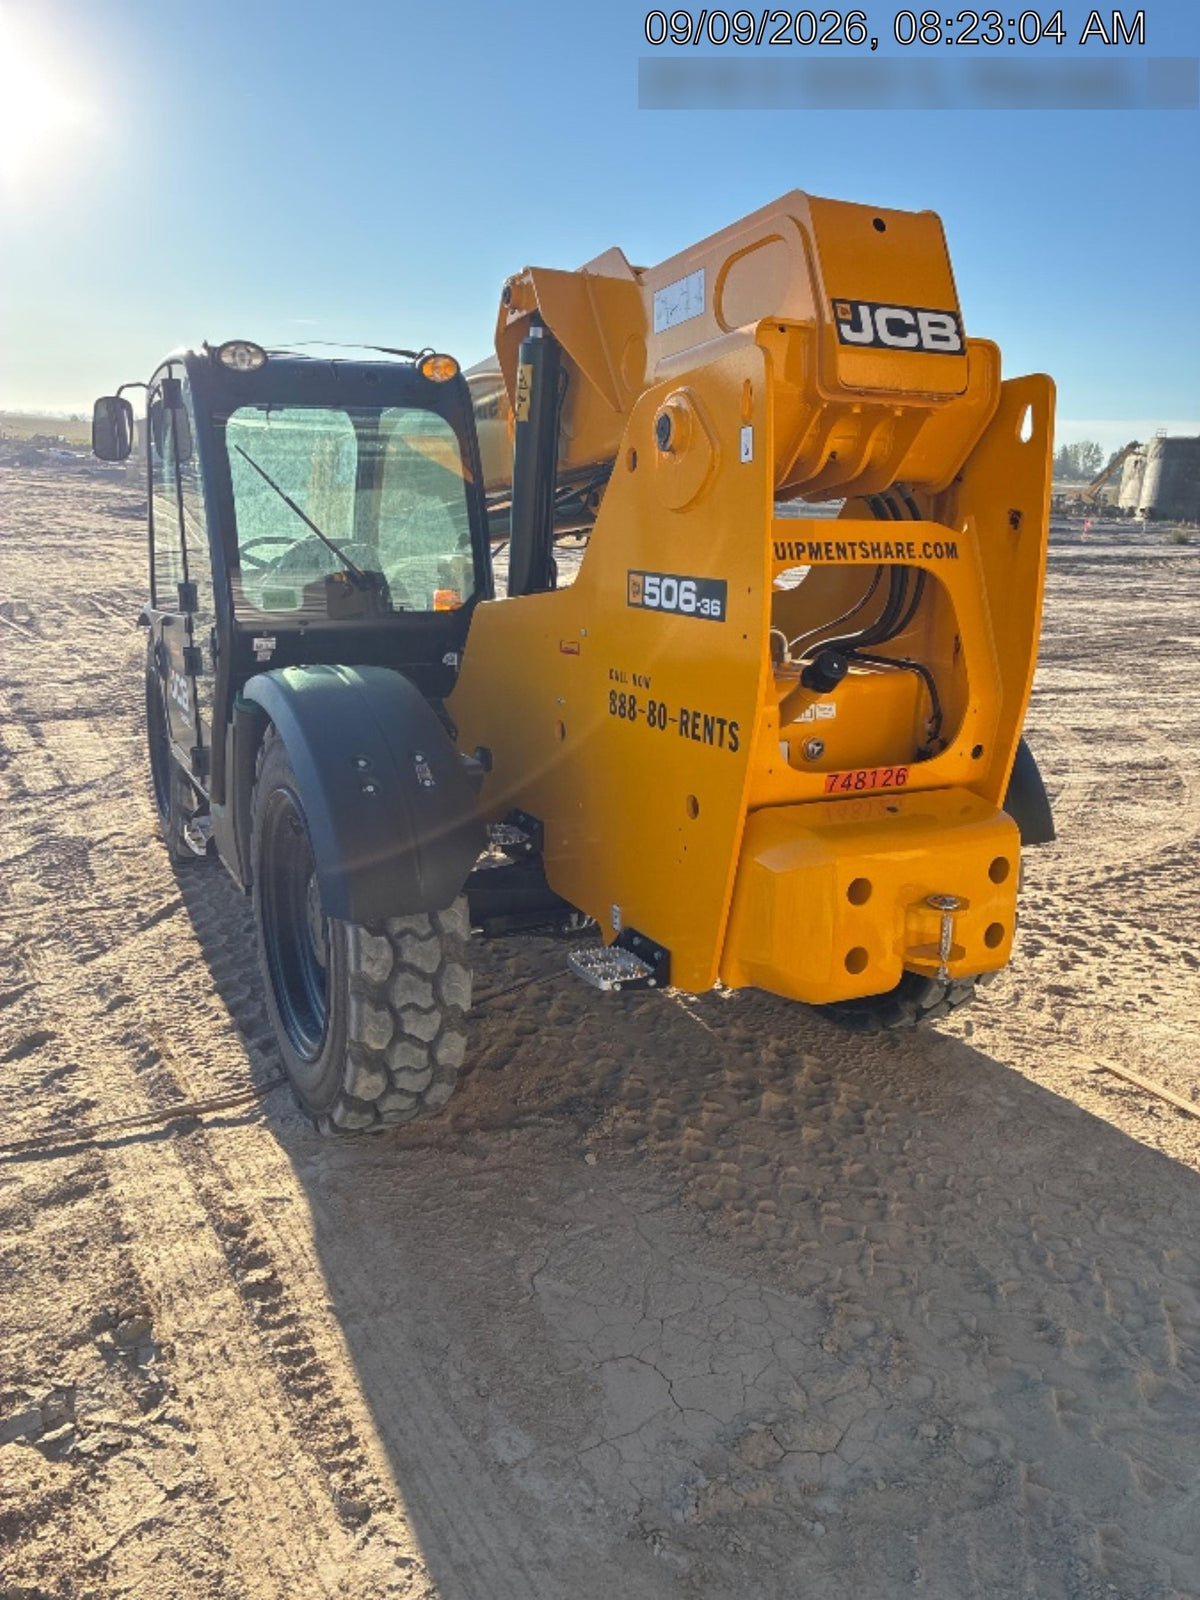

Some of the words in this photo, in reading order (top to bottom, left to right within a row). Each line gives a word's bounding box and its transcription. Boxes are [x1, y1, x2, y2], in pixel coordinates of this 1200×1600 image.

[839, 305, 962, 352] JCB
[773, 541, 959, 561] UIPMENTSHARE.COM
[643, 575, 721, 616] 506-36
[609, 668, 629, 684] CALL
[632, 673, 652, 689] NOW
[609, 689, 740, 753] 888-80-RENTS
[826, 767, 908, 793] 748126
